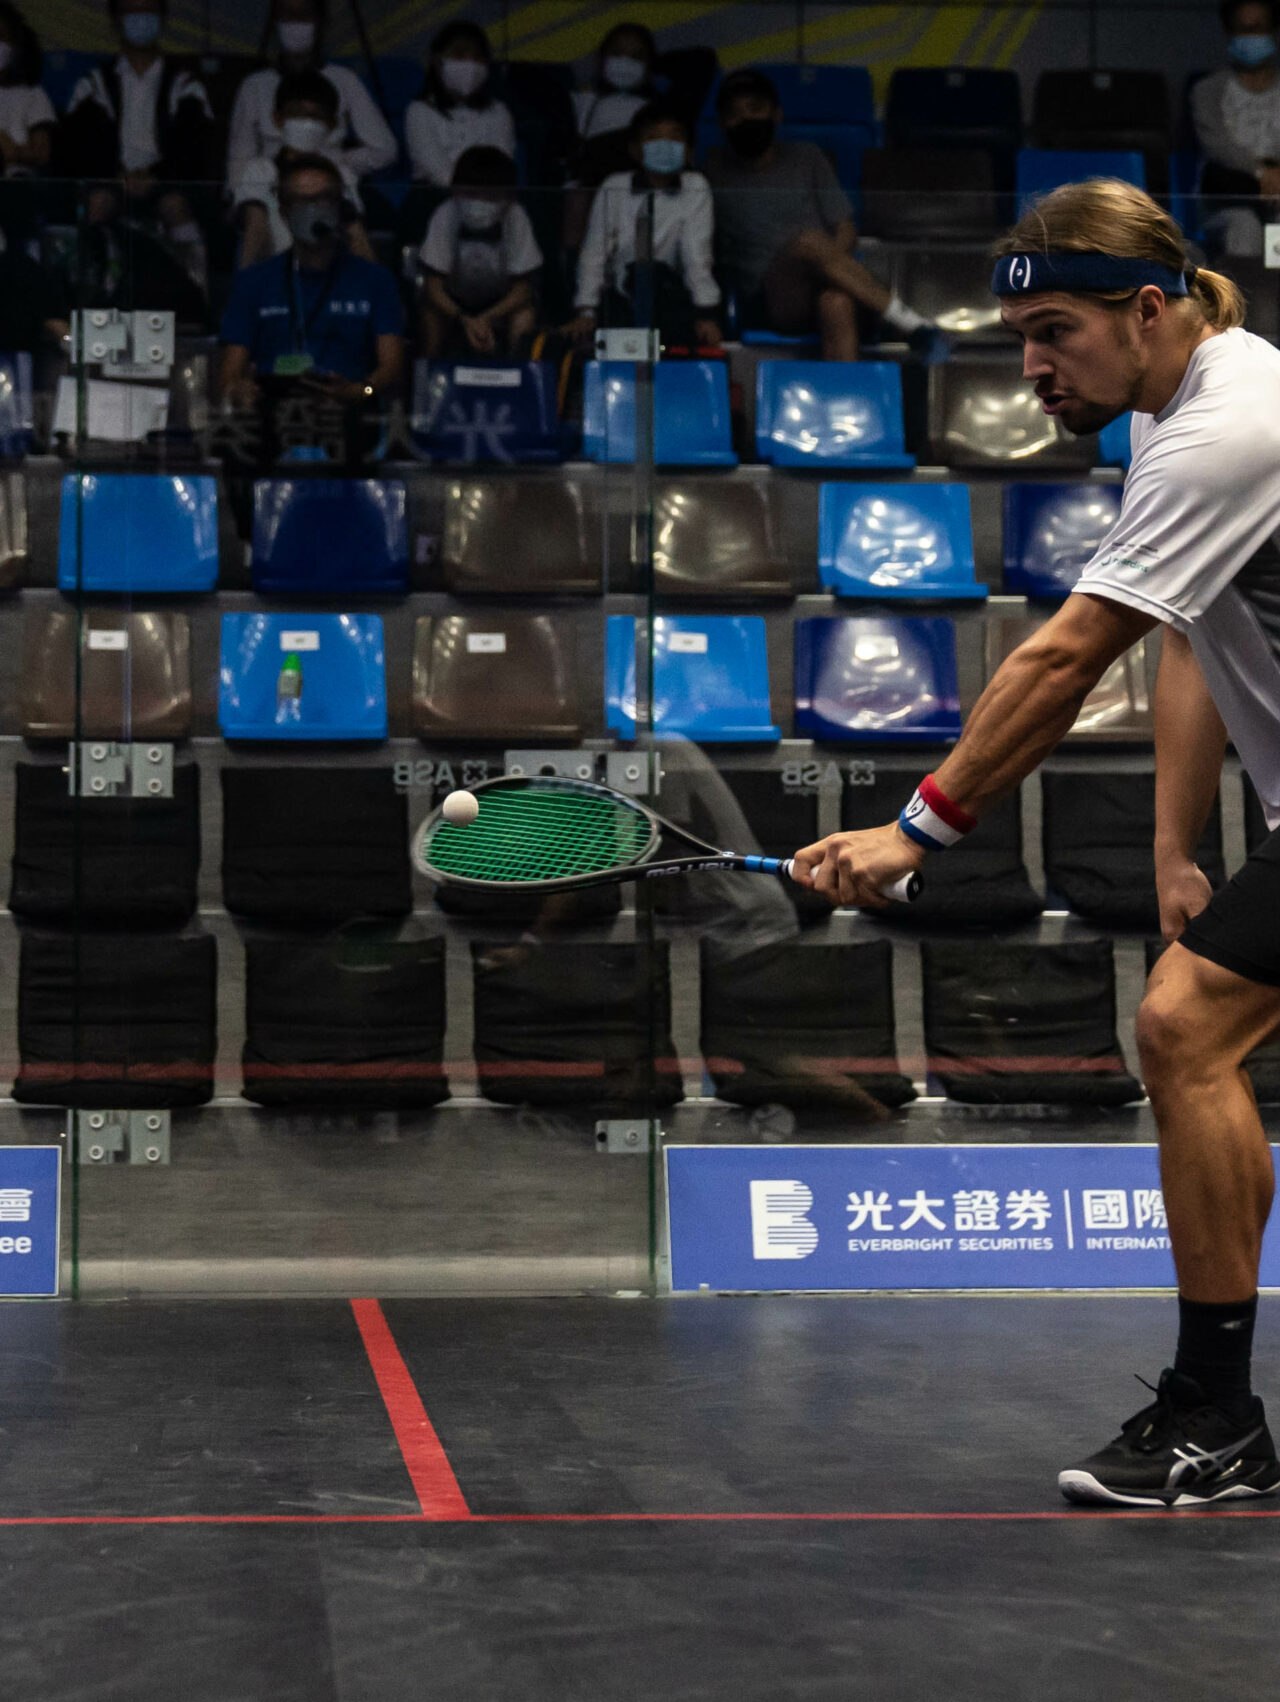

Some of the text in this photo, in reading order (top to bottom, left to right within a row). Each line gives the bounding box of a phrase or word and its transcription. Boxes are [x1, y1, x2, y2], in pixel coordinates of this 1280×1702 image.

[846, 1189, 1053, 1231] 光大證券
[849, 1239, 953, 1252] EVERBRIGHT
[959, 1237, 1054, 1250] SECURITIES
